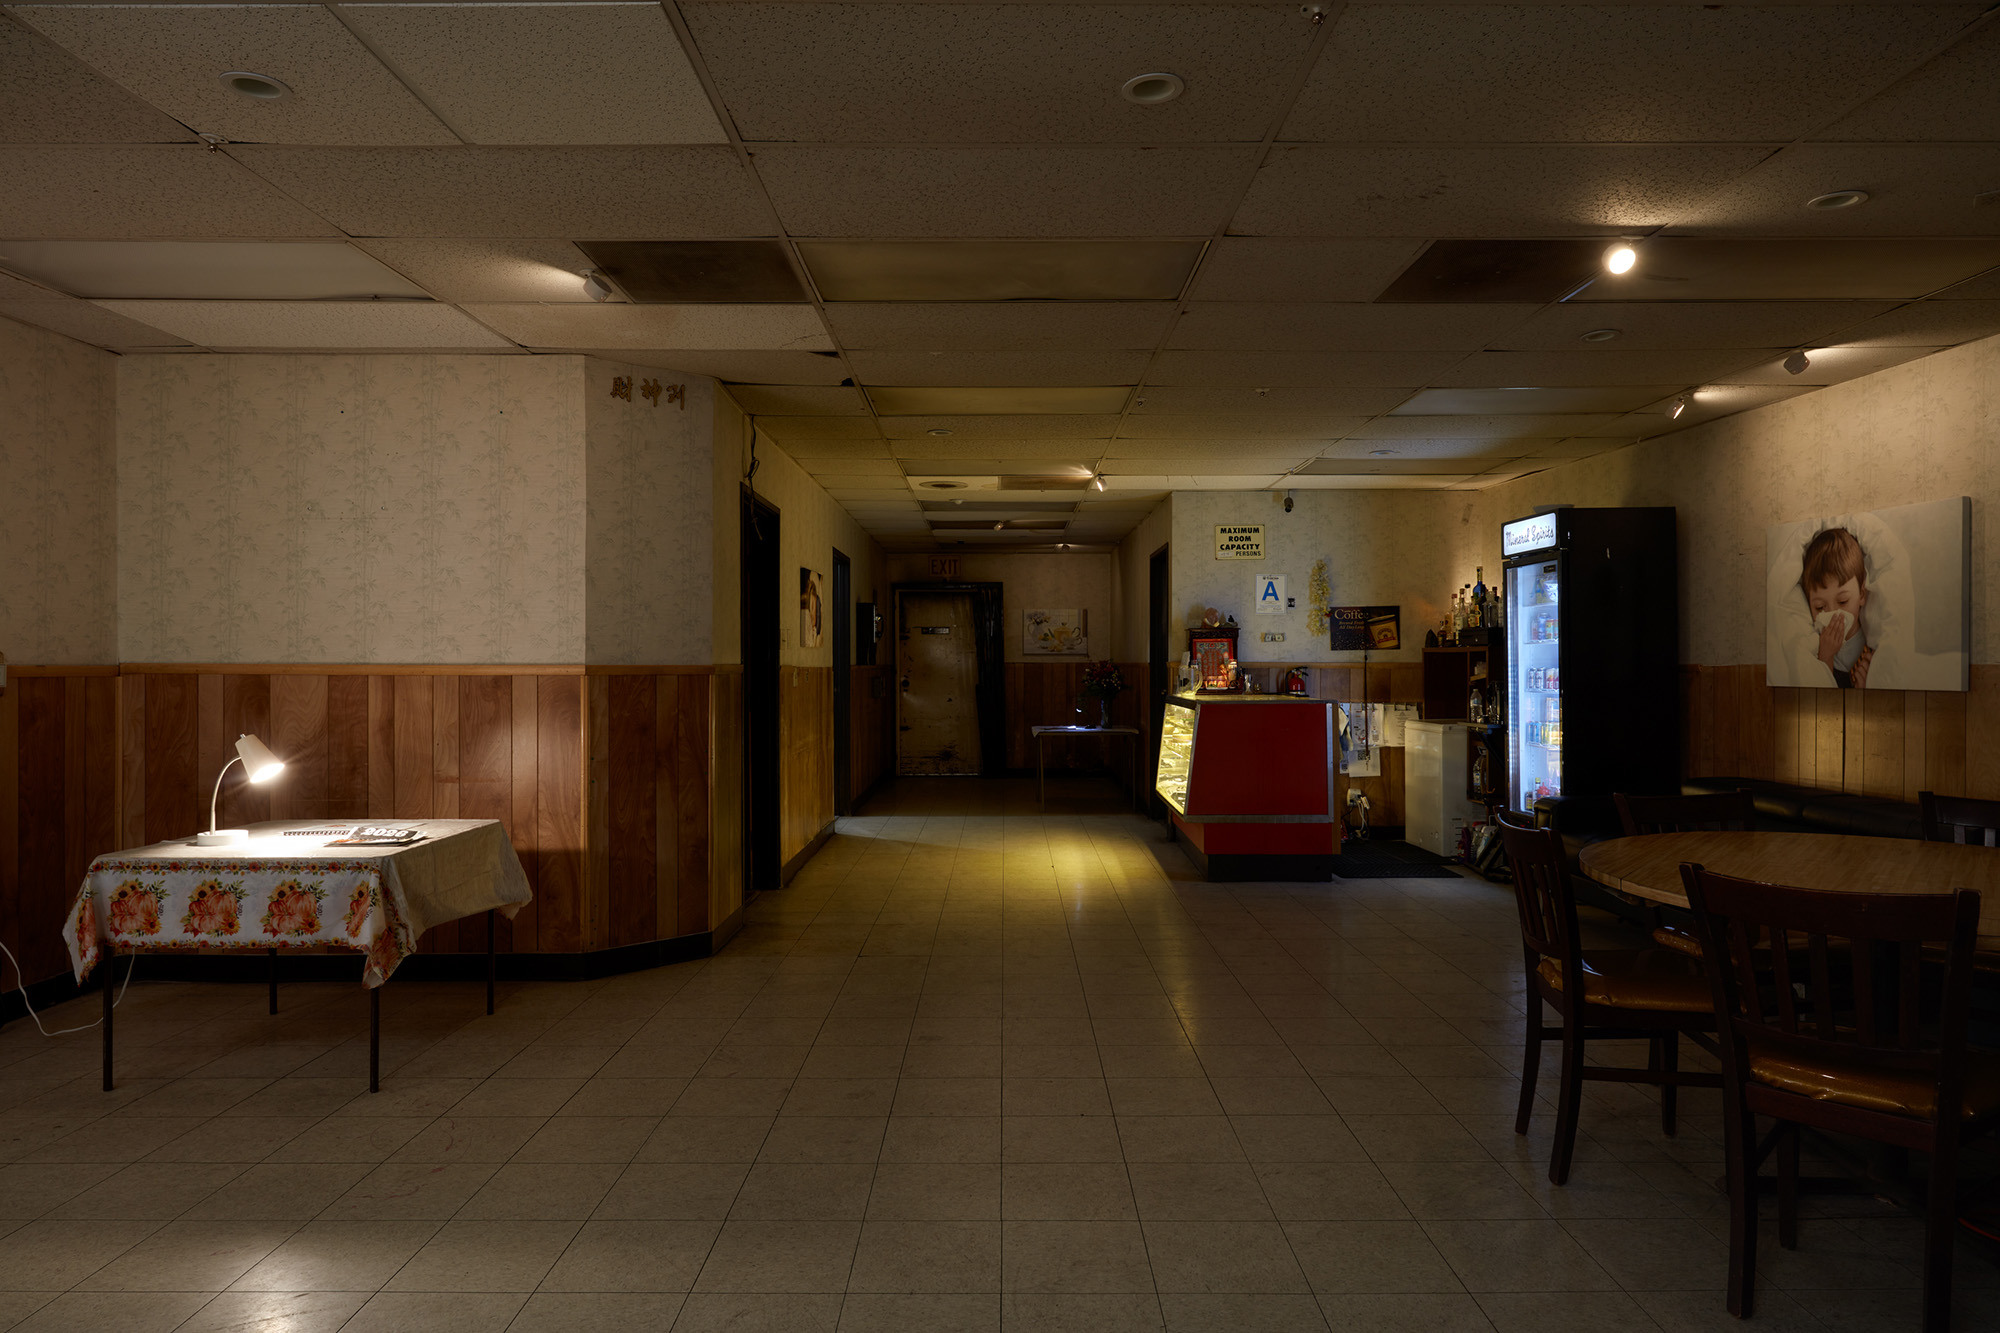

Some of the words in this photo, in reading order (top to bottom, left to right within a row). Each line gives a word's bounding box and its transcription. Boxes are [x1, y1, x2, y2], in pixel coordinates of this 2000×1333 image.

[1505, 528, 1530, 547] Mineral
[1531, 525, 1554, 545] Spirits
[932, 560, 958, 574] EXIT
[1262, 581, 1280, 601] A
[1334, 608, 1369, 620] Coffee
